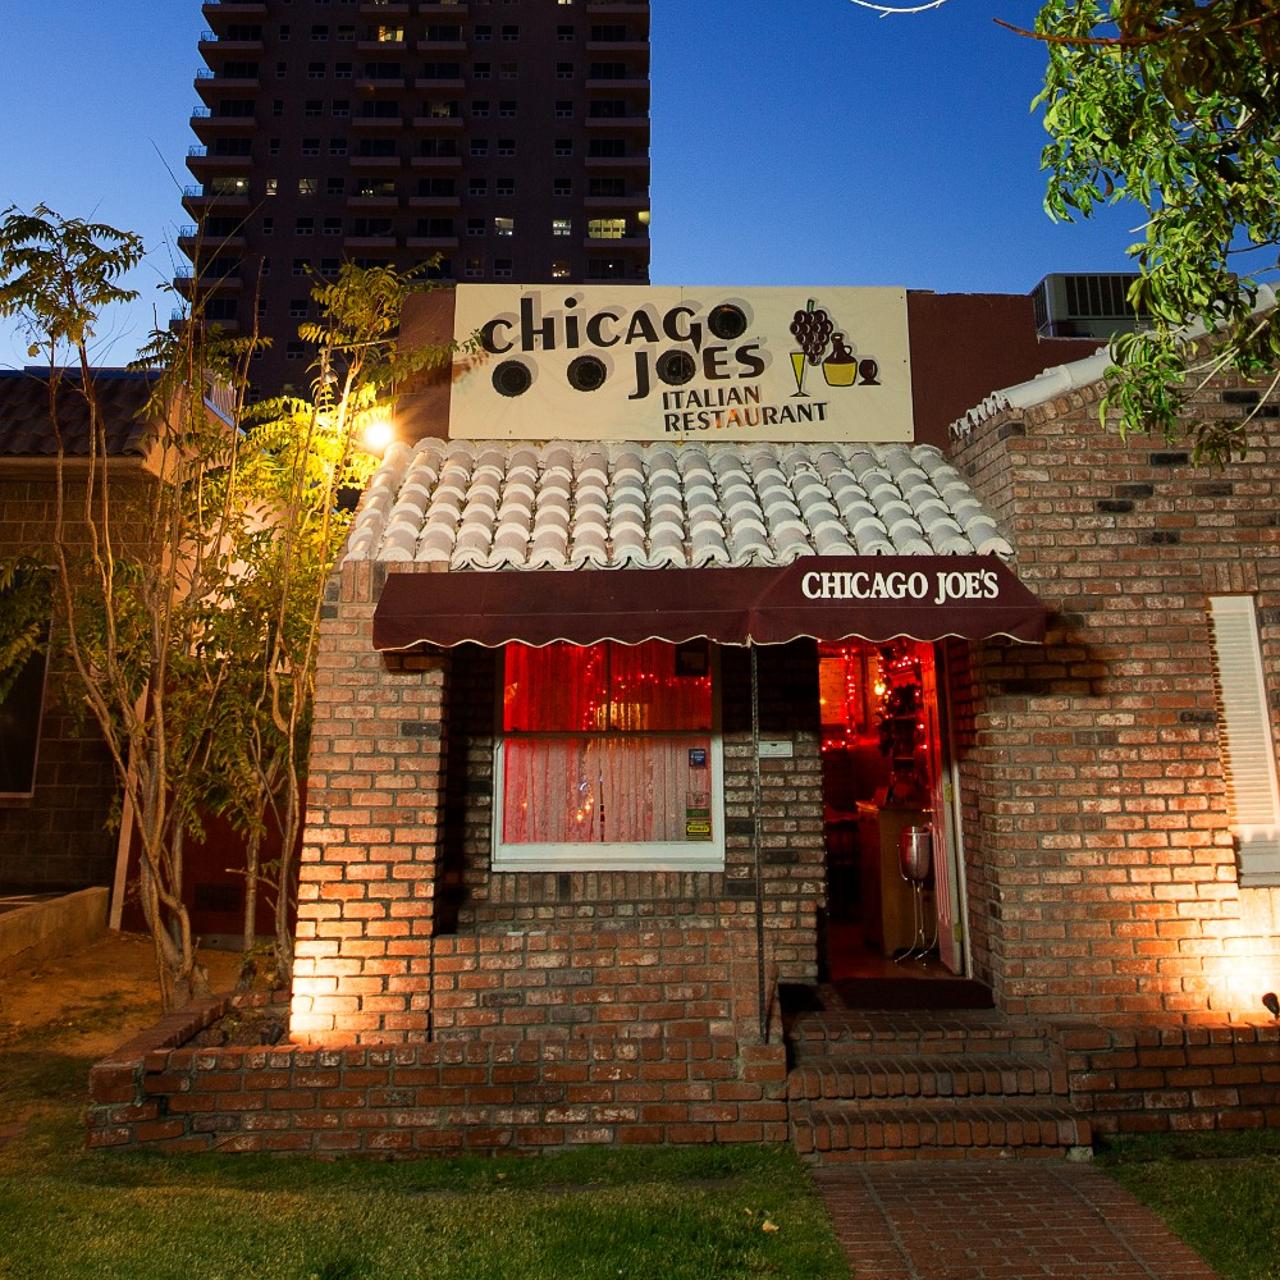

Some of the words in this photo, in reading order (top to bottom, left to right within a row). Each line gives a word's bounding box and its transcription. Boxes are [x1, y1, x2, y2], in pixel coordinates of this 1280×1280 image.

[628, 344, 765, 400] JOES
[662, 385, 760, 410] ITALIAN
[663, 402, 828, 433] RESTAURANT
[801, 571, 929, 599] CHICAGO
[934, 568, 999, 605] JOE'S
